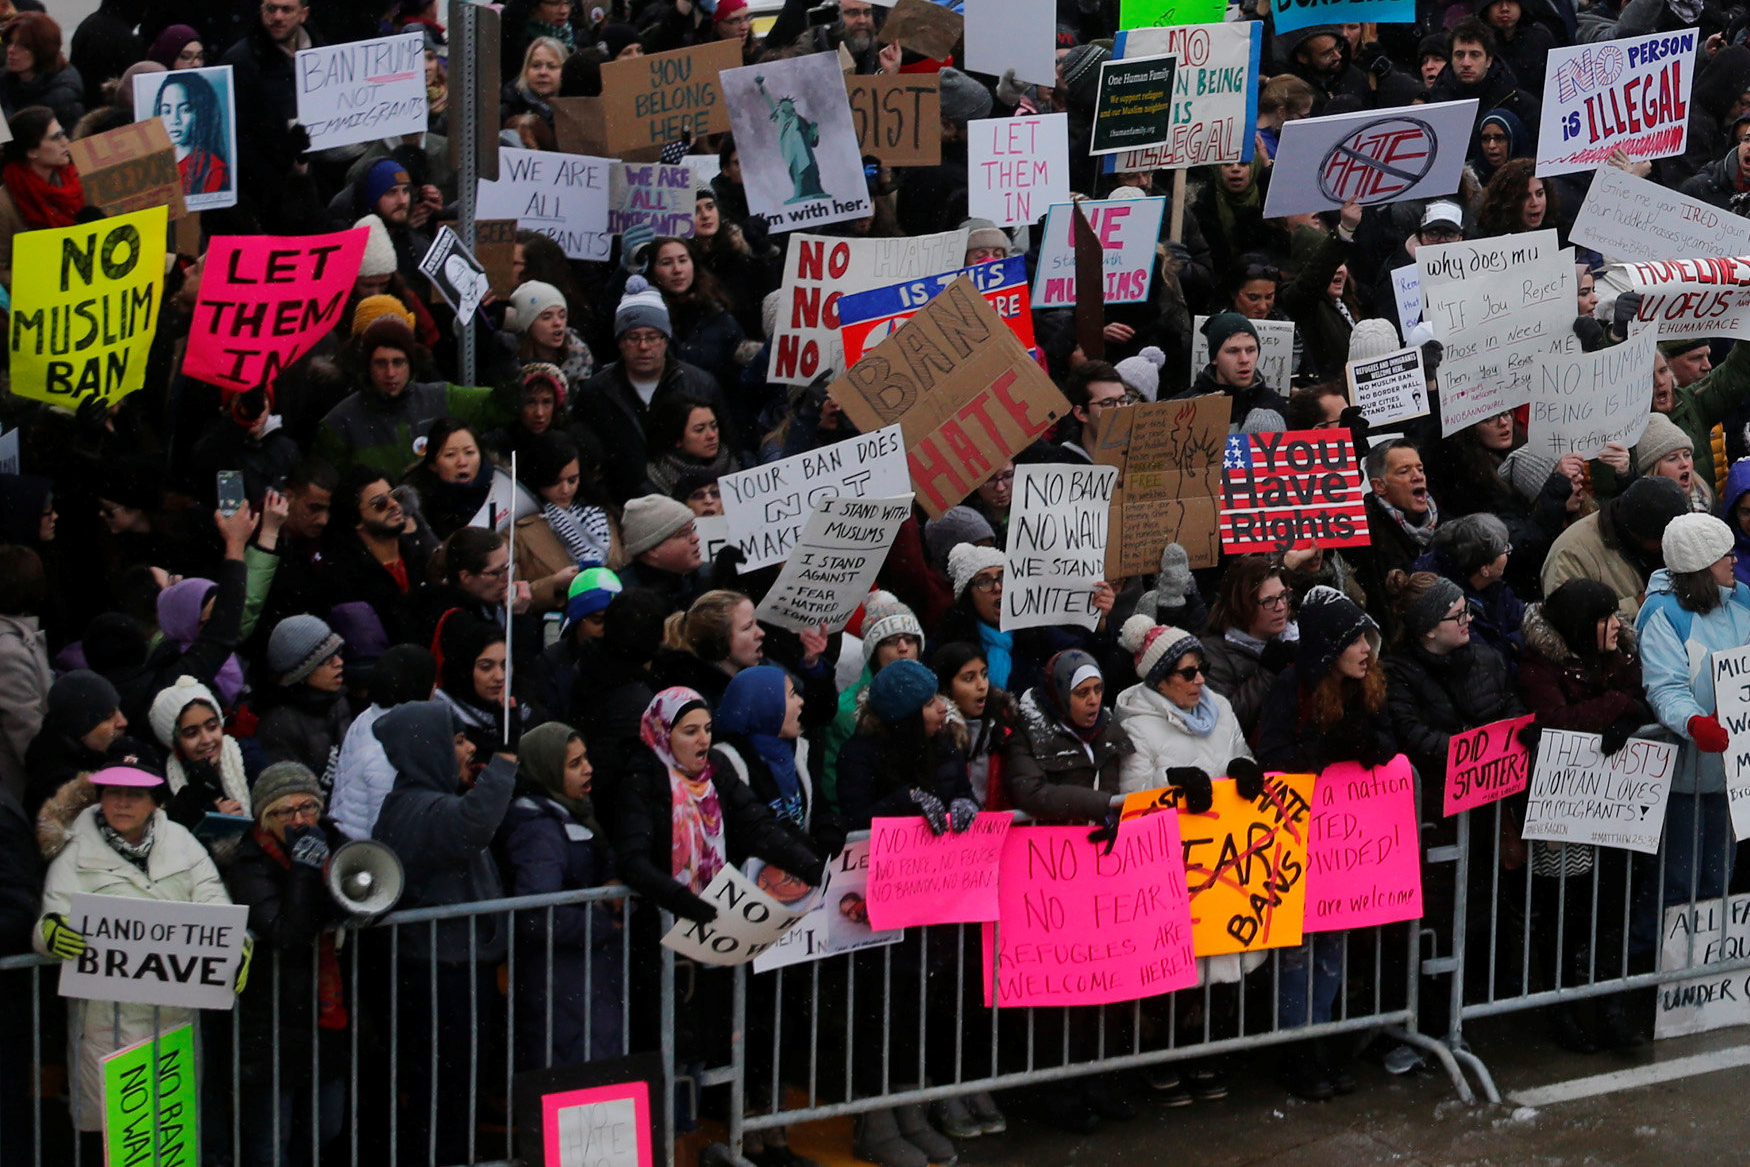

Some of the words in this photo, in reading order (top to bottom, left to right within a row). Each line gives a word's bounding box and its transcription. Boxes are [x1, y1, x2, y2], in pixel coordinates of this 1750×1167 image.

[1169, 29, 1210, 67] NO
[302, 49, 357, 94] BAN
[652, 54, 691, 88] YOU
[1108, 74, 1122, 85] One
[1123, 71, 1148, 84] Human
[1197, 67, 1243, 97] BEING
[1552, 44, 1625, 103] NO
[1628, 33, 1694, 69] PERSON
[338, 85, 377, 109] NOT
[637, 82, 716, 118] BELONG
[1174, 101, 1193, 124] IS
[1583, 60, 1687, 144] ILLEGAL
[305, 98, 426, 135] IMMIGRANTS
[651, 111, 709, 142] HERE
[993, 121, 1041, 154] LET
[506, 155, 549, 183] WE
[555, 161, 601, 189] ARE
[625, 166, 652, 186] WE
[980, 161, 1048, 189] THEM
[1005, 193, 1031, 222] IN
[61, 224, 140, 291] NO
[227, 244, 341, 284] LET
[799, 239, 849, 280] NO
[13, 282, 153, 354] MUSLIM
[203, 291, 344, 337] THEM
[773, 336, 819, 379] NO
[848, 284, 991, 425] BAN
[1355, 363, 1379, 375] REFUGEES
[48, 347, 129, 397] BAN
[1372, 378, 1396, 388] MUSLIM
[1542, 363, 1582, 395] NO
[1373, 386, 1400, 397] BORDER
[1362, 407, 1385, 416] STAND
[1534, 402, 1594, 422] BEING
[726, 468, 780, 504] YOUR
[804, 448, 842, 478] BAN
[856, 430, 898, 464] DOES
[1250, 432, 1349, 473] You
[1024, 474, 1065, 507] NO
[1222, 469, 1349, 509] Have
[840, 501, 879, 518] STAND
[824, 522, 886, 543] MUSLIMS
[1018, 516, 1068, 551] NO
[799, 570, 860, 583] AGAINST
[818, 556, 866, 570] STAND
[1009, 558, 1048, 580] WE
[1053, 558, 1105, 578] STAND
[1544, 730, 1602, 767] THIS
[1348, 768, 1409, 800] nation
[1453, 750, 1529, 802] STUTTER?
[1535, 767, 1600, 797] WOMAN
[1603, 773, 1662, 804] LOVES
[1027, 837, 1077, 881] NO
[714, 880, 770, 924] NO
[1023, 894, 1065, 934] NO
[1227, 851, 1301, 947] BANS
[1318, 896, 1342, 916] are
[1350, 884, 1414, 913] welcome
[81, 914, 146, 941] LAND
[150, 924, 177, 942] OF
[181, 923, 233, 948] THE
[999, 938, 1135, 969] REFUGEES
[1154, 923, 1185, 950] ARE
[76, 947, 227, 987] BRAVE
[999, 973, 1121, 1001] WELCOME
[1663, 978, 1734, 1011] UNDER
